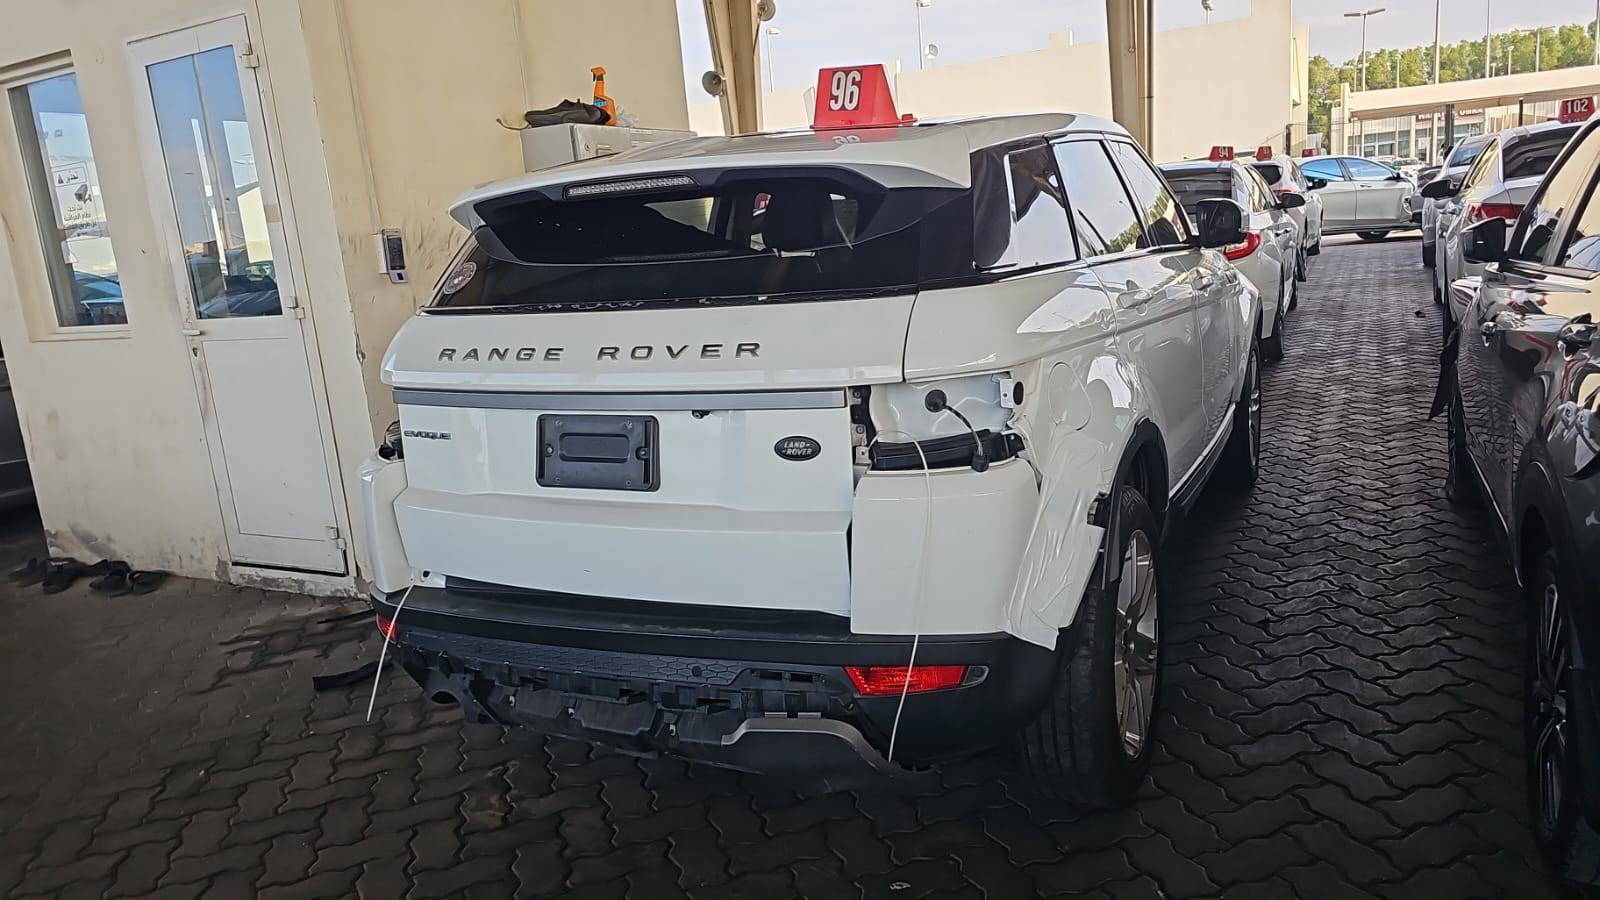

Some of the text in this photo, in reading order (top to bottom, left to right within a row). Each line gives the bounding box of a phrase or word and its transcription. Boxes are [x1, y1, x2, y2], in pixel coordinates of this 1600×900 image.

[829, 70, 861, 111] 96
[1567, 99, 1588, 114] 102
[1219, 146, 1229, 158] 94
[438, 343, 761, 361] RANGE ROVER
[404, 430, 452, 440] EVOQUE
